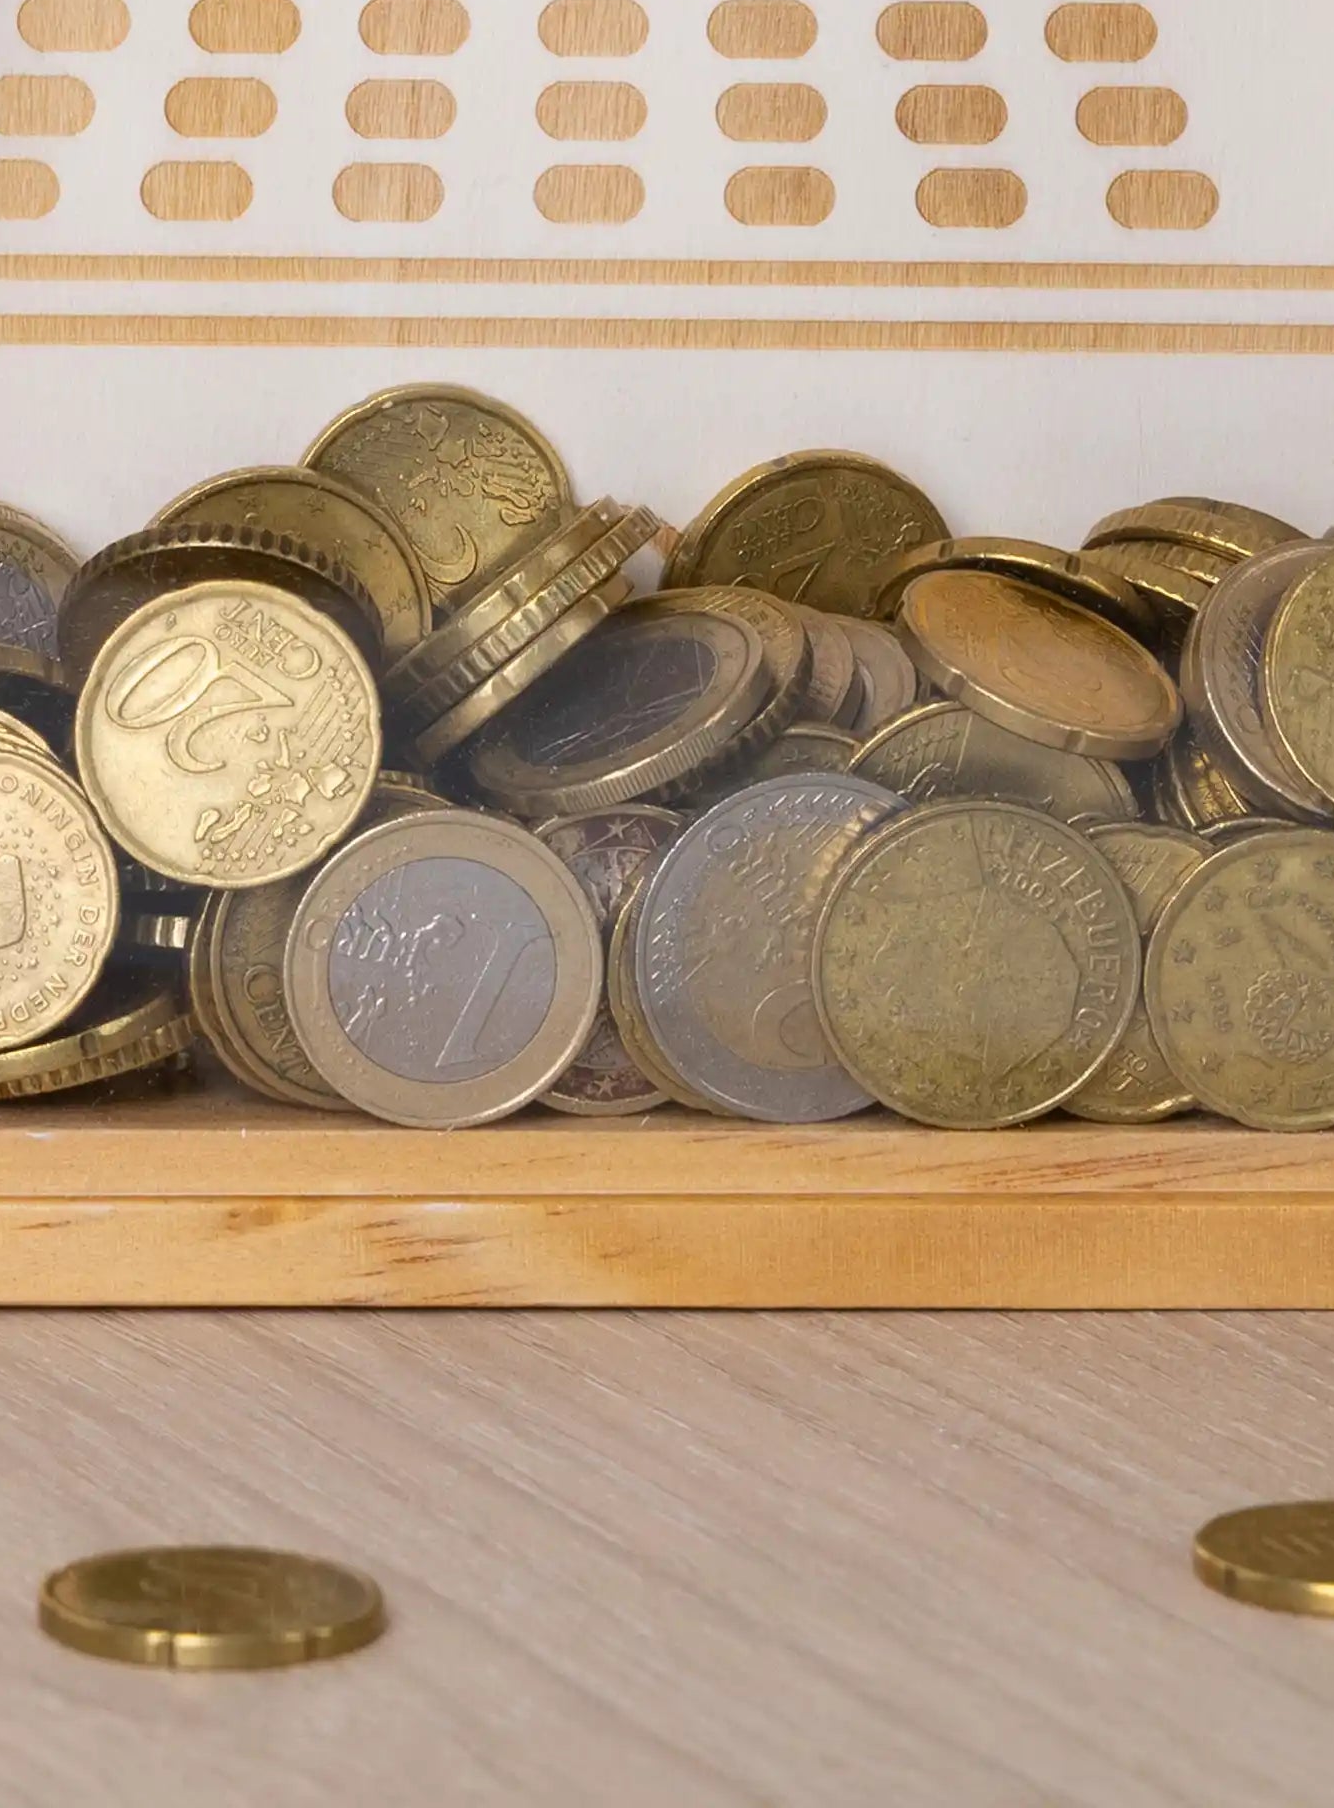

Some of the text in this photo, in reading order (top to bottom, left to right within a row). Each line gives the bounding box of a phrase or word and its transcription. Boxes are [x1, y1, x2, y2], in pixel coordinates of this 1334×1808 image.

[220, 598, 323, 681] CENT
[104, 636, 295, 775] 20
[64, 904, 101, 969] DER
